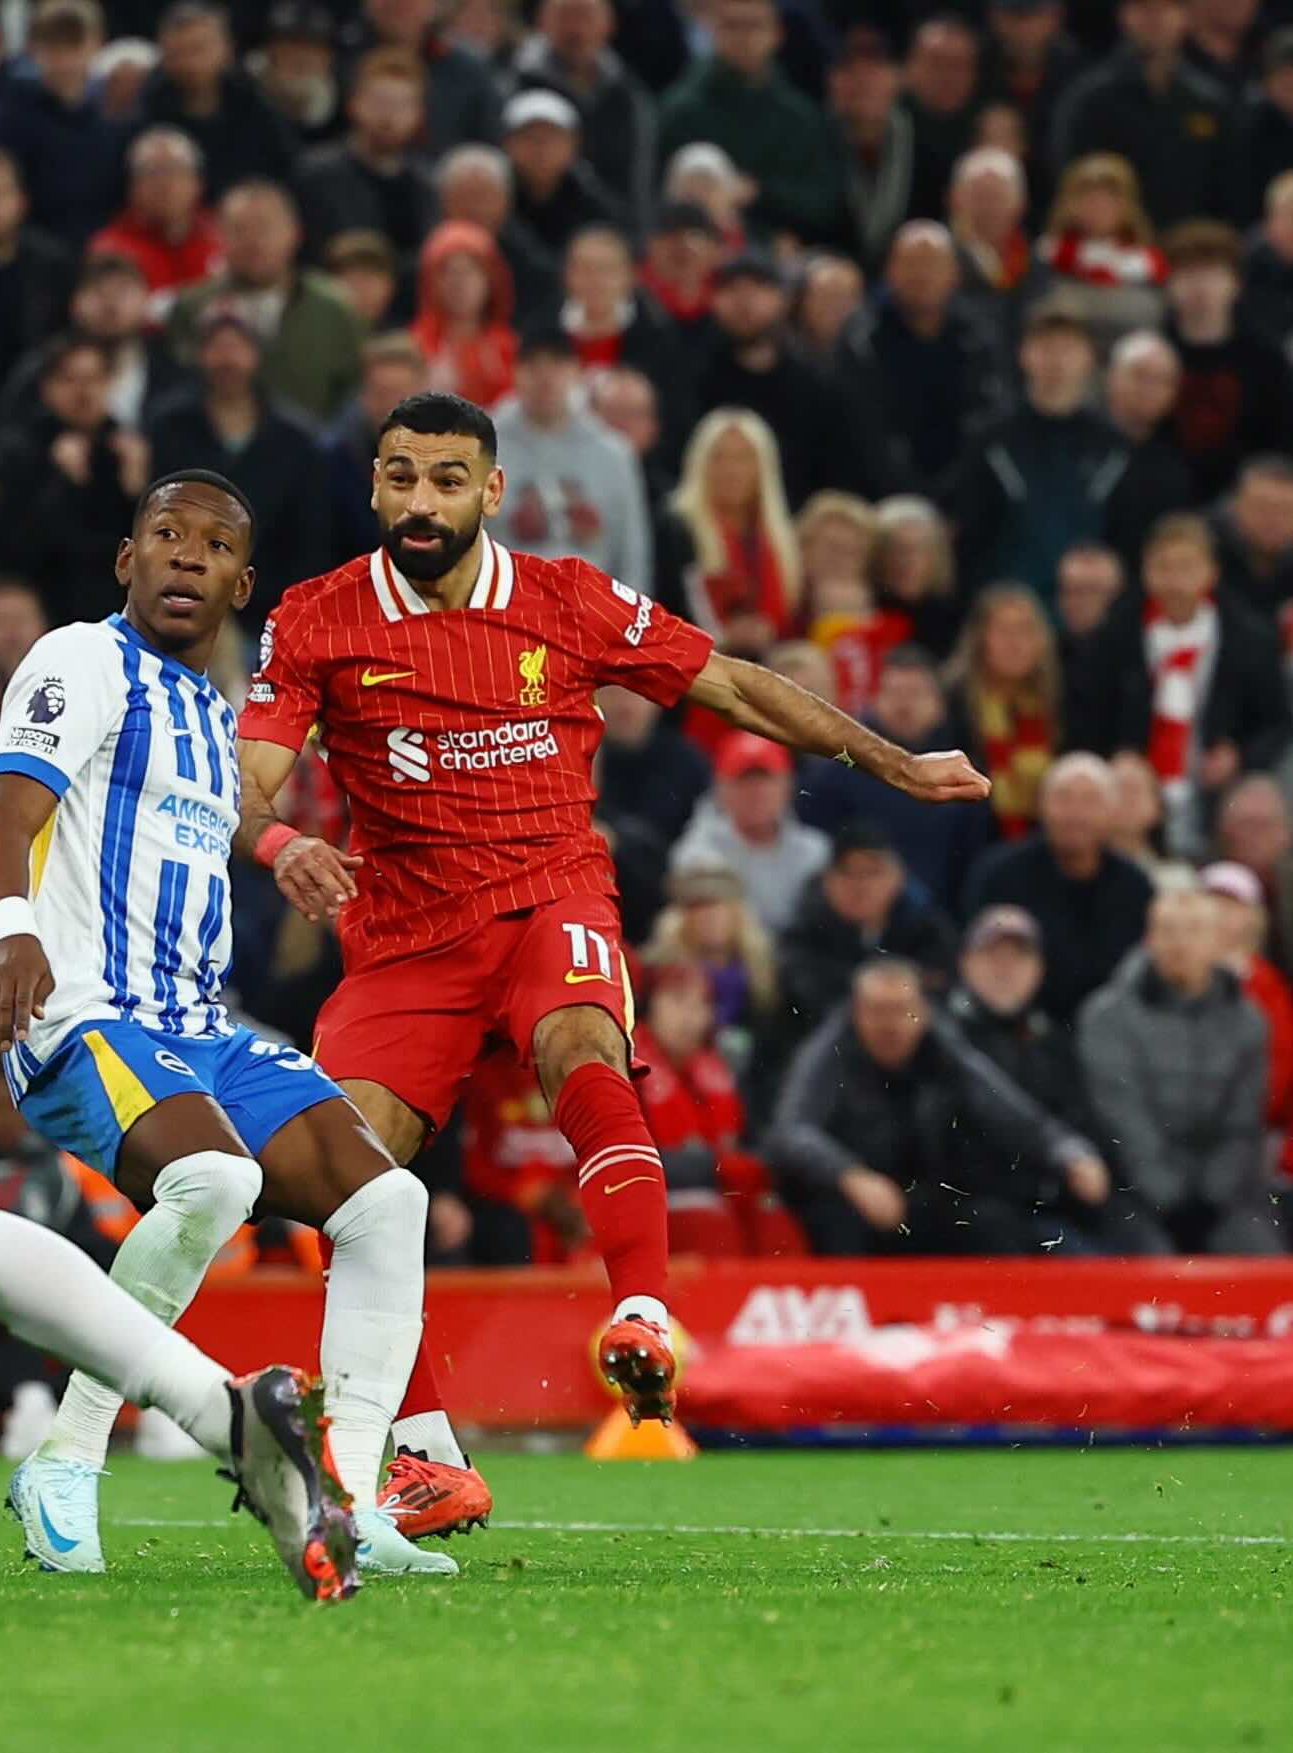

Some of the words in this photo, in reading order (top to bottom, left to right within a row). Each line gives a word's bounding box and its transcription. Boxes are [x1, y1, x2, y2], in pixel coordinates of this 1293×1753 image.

[519, 691, 547, 706] LFC
[440, 733, 559, 770] chartered
[176, 823, 229, 860] EXPR
[562, 923, 612, 979] 11
